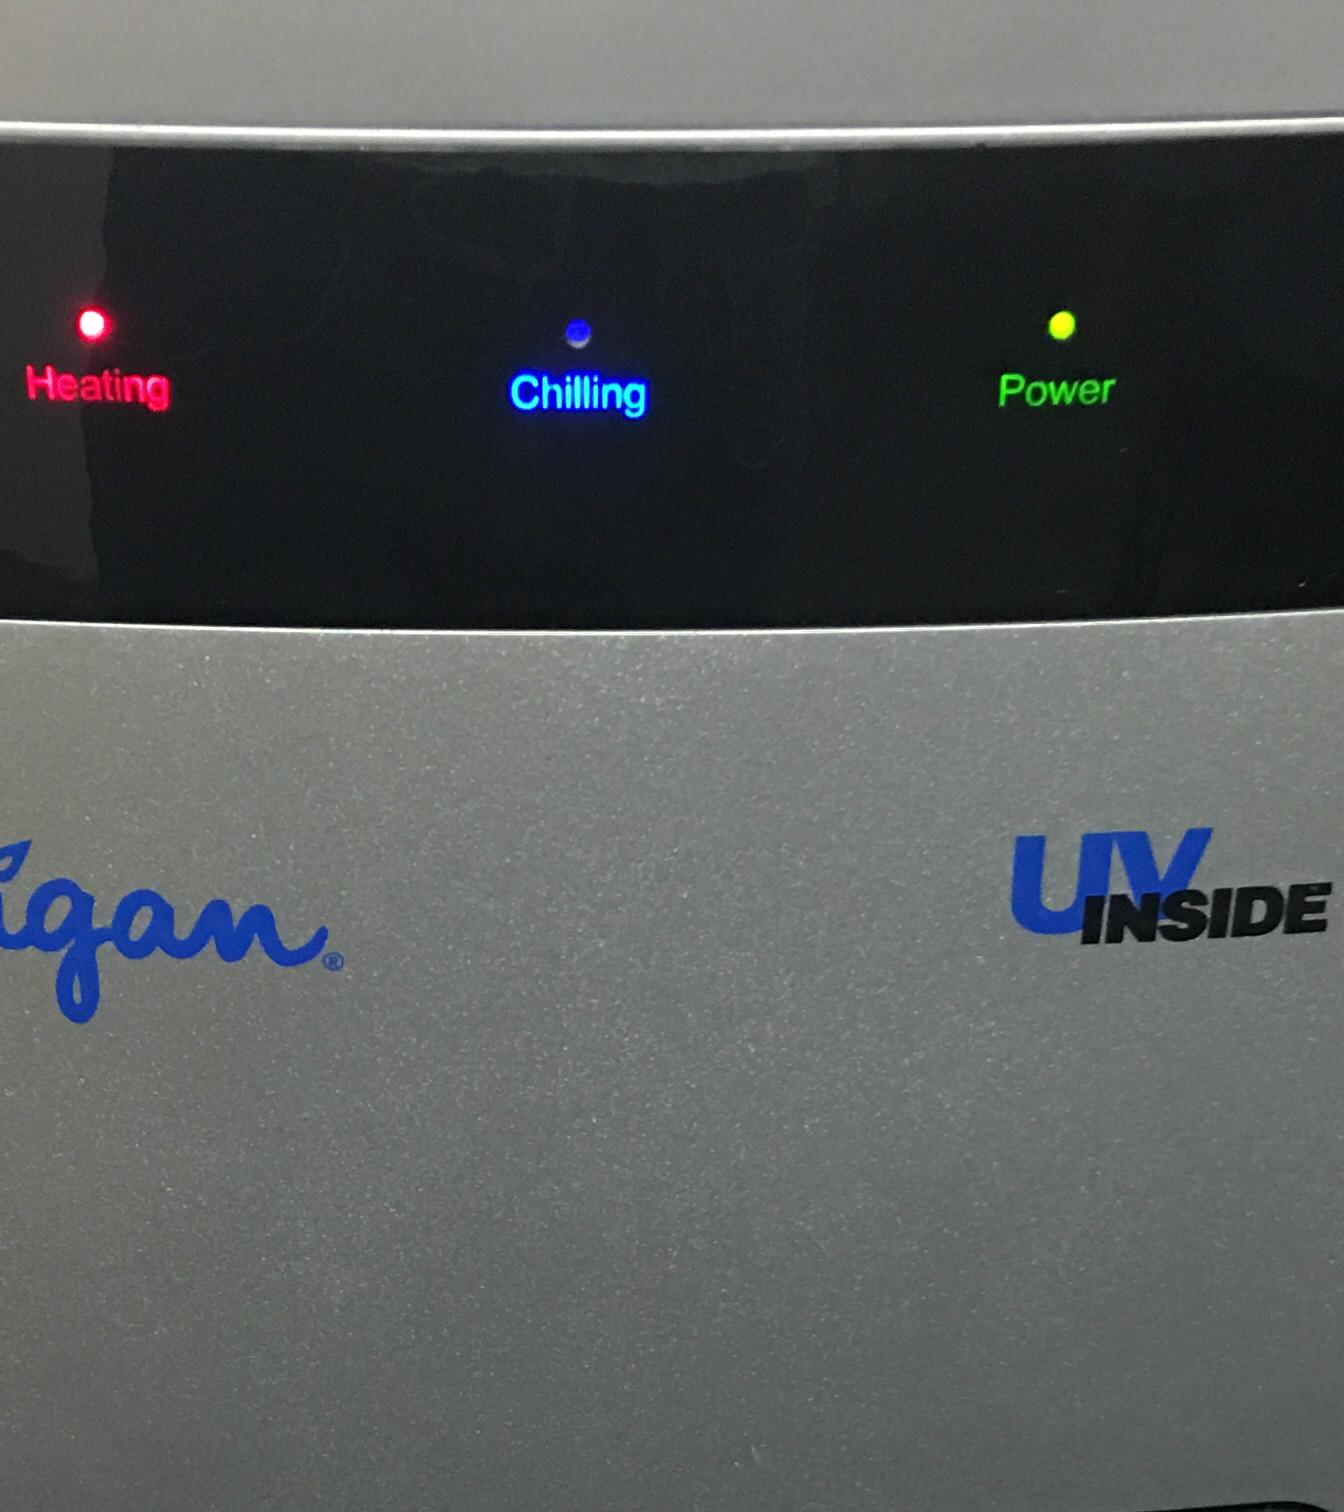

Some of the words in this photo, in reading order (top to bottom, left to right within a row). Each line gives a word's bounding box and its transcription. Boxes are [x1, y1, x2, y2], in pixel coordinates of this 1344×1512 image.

[26, 363, 170, 412] Heating
[511, 373, 646, 418] Chilling
[998, 372, 1117, 407] Power
[1010, 826, 1214, 936] UV
[1080, 881, 1334, 945] INSIDE
